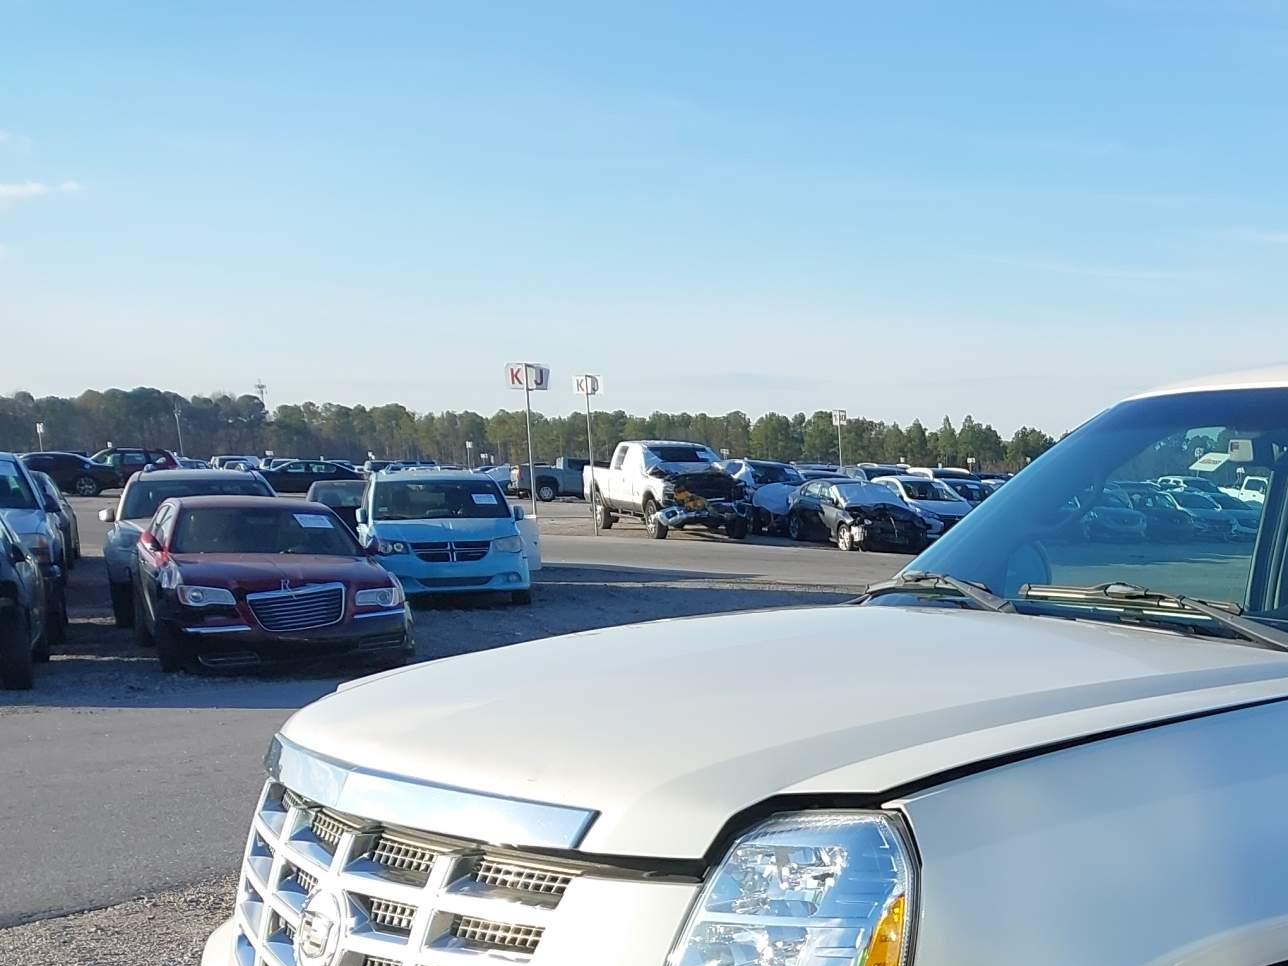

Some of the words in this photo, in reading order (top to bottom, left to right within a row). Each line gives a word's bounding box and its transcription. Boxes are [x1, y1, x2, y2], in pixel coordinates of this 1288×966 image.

[510, 368, 523, 385] K
[534, 368, 545, 386] J
[576, 378, 585, 392] K
